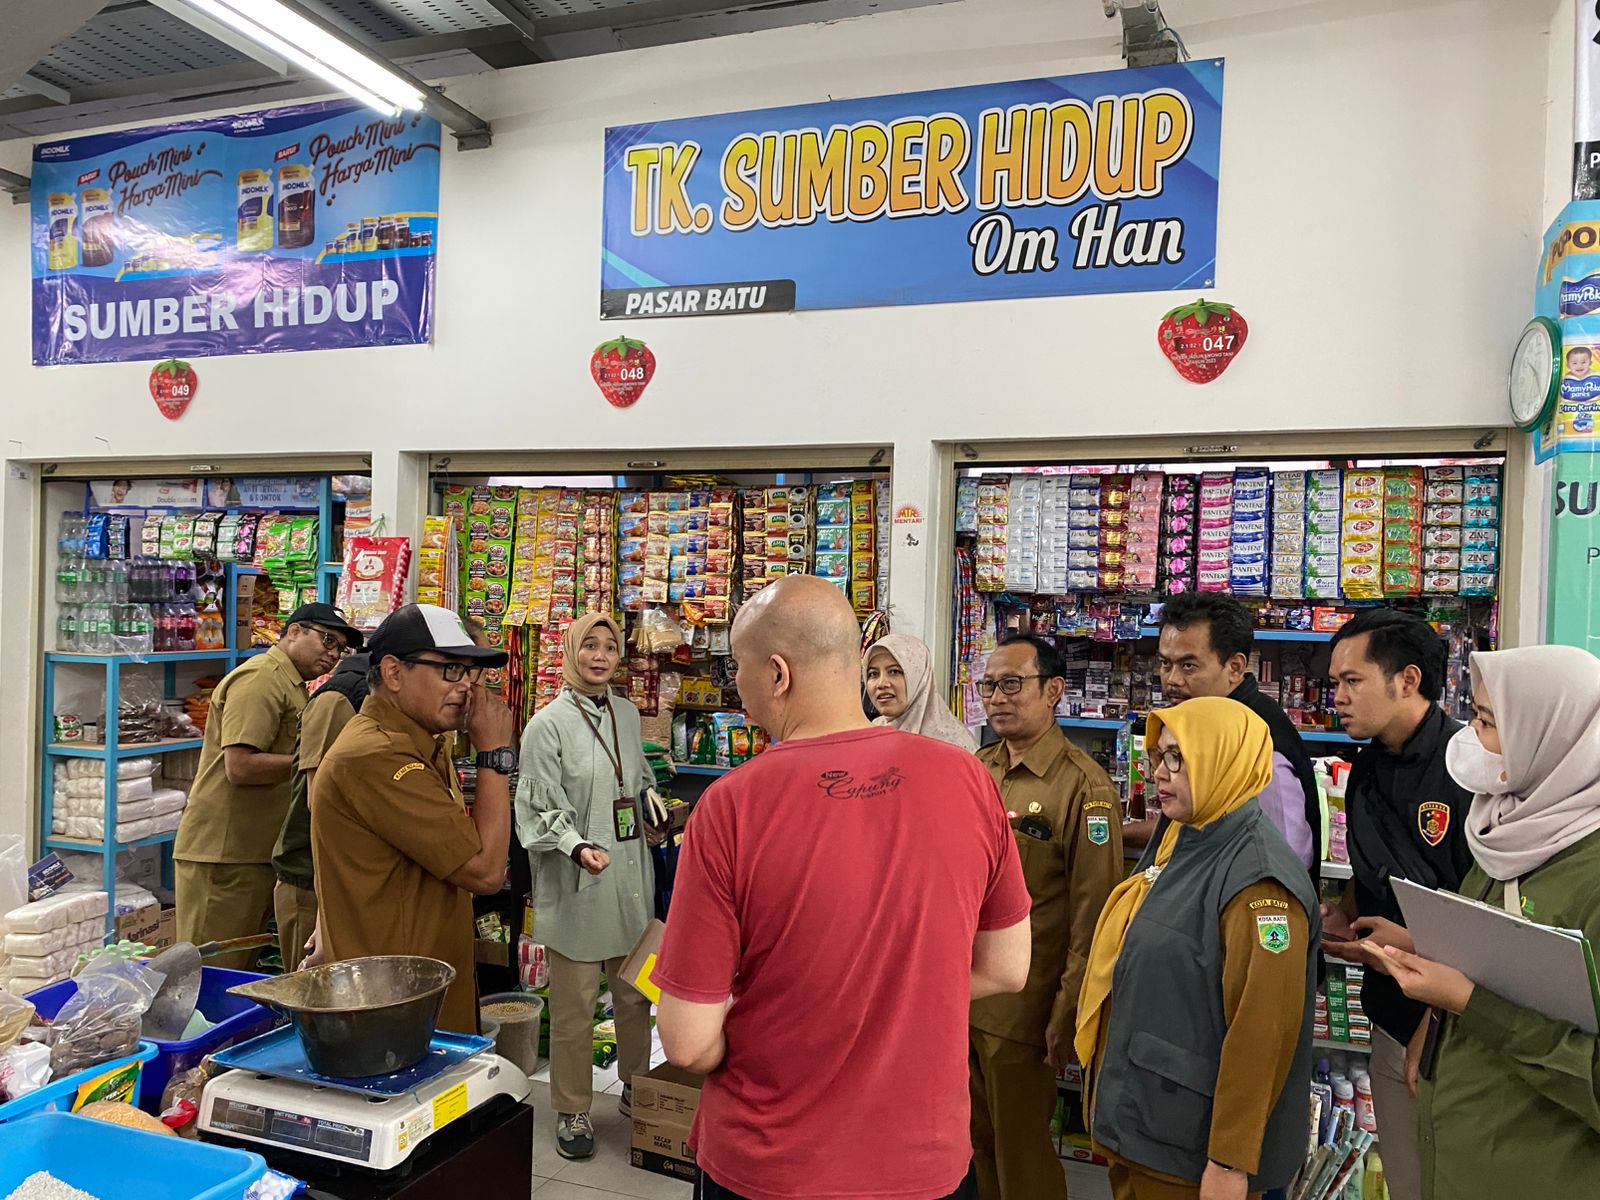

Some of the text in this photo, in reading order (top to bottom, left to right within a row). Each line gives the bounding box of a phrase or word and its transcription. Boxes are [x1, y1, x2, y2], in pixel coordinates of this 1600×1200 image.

[309, 117, 406, 165] Pouch Mini
[625, 90, 1190, 234] TK. SUMBER HIDUP
[108, 145, 193, 189] Pouch Mini
[320, 144, 424, 196] Harga Mini
[118, 170, 208, 219] Harga Mini
[968, 204, 1183, 275] Om Han
[63, 279, 399, 342] SUMBER HIDUP
[625, 286, 767, 315] PASAR BATU
[1202, 335, 1235, 352] 047
[172, 384, 189, 396] 049
[620, 367, 644, 381] 048
